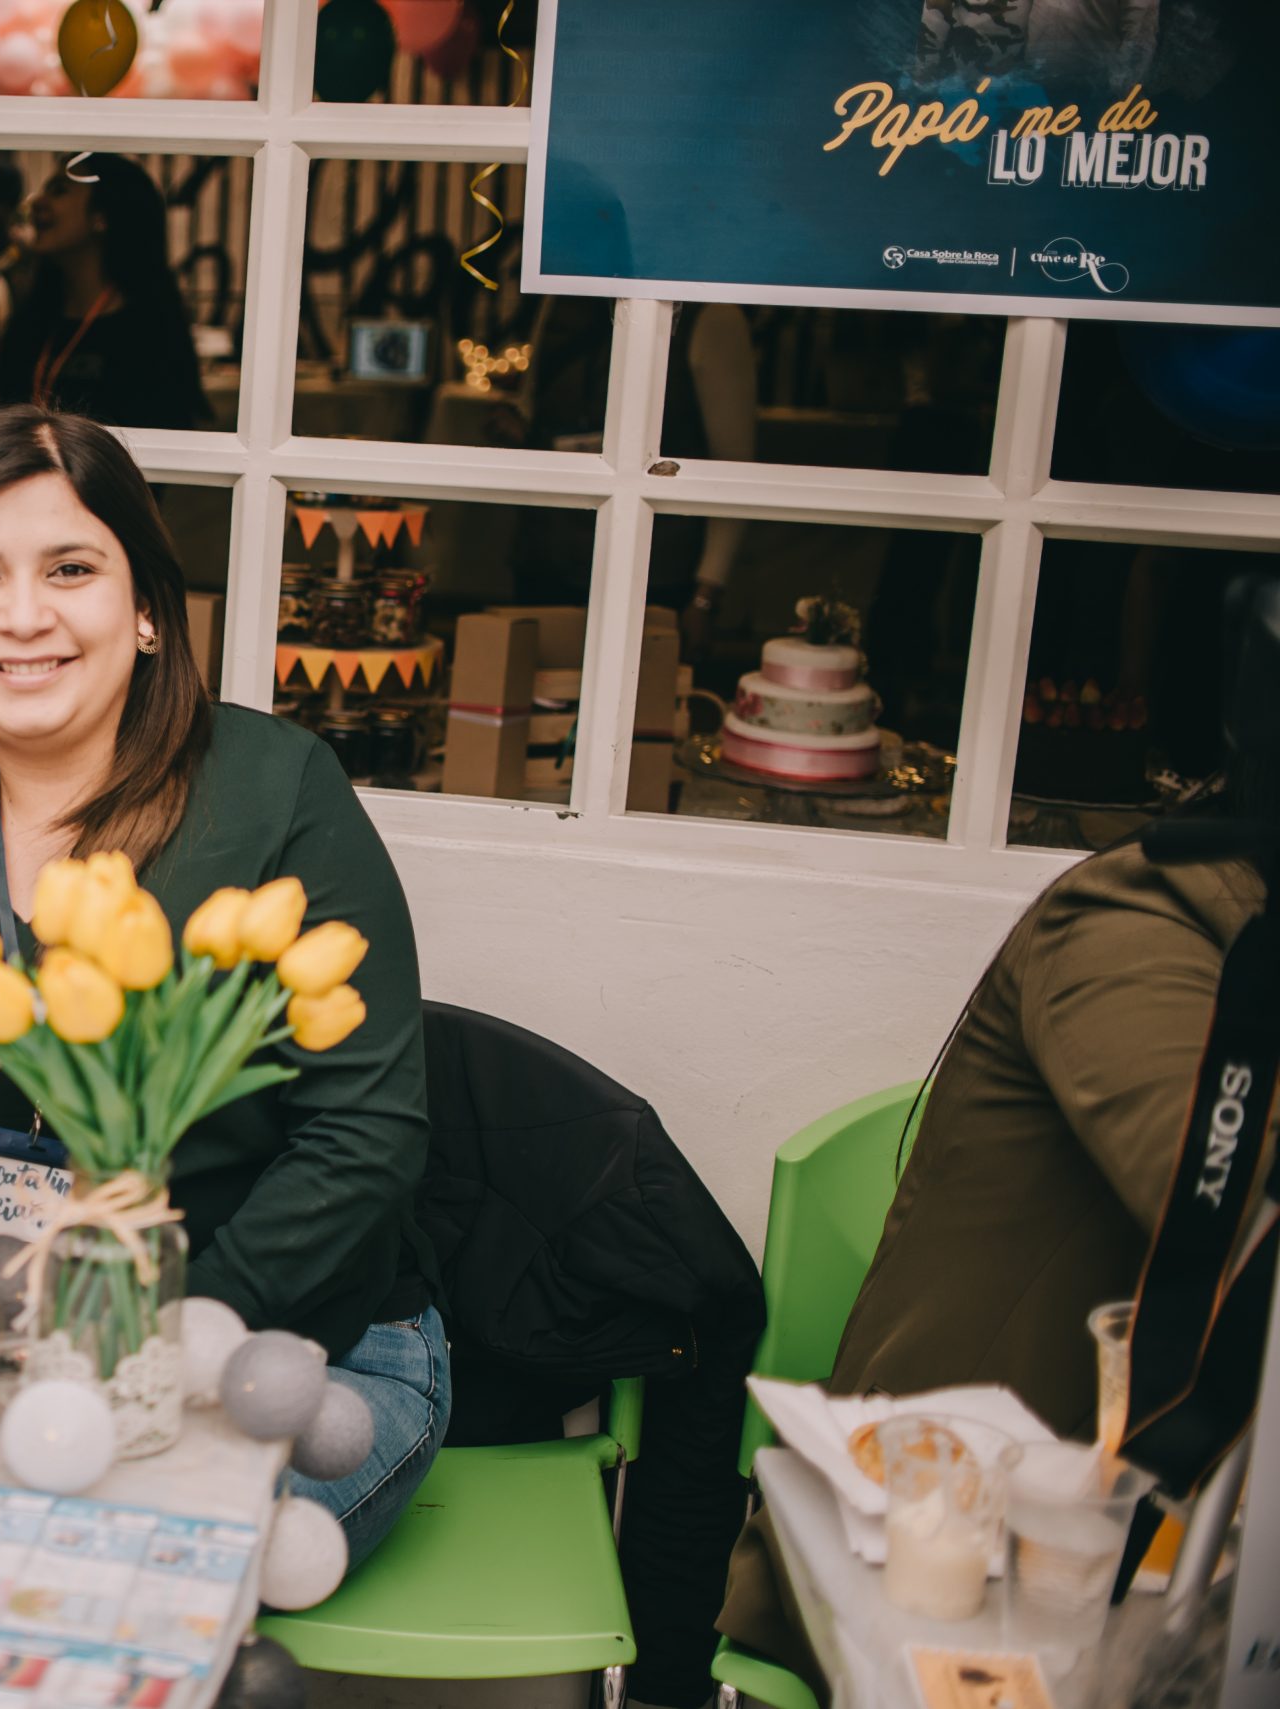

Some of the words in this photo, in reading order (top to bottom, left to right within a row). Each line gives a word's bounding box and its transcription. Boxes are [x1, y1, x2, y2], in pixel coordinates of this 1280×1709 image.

[823, 78, 991, 176] Papá
[1010, 104, 1081, 139] me
[1098, 84, 1158, 133] da
[988, 130, 1046, 185] LO
[1063, 131, 1210, 190] MEJOR
[907, 249, 931, 258] Casa
[932, 250, 962, 260] Sobre
[963, 251, 973, 260] la
[974, 252, 999, 261] Roca
[1030, 252, 1061, 263] Clave
[1063, 254, 1078, 264] de
[1195, 1061, 1252, 1212] SONY
